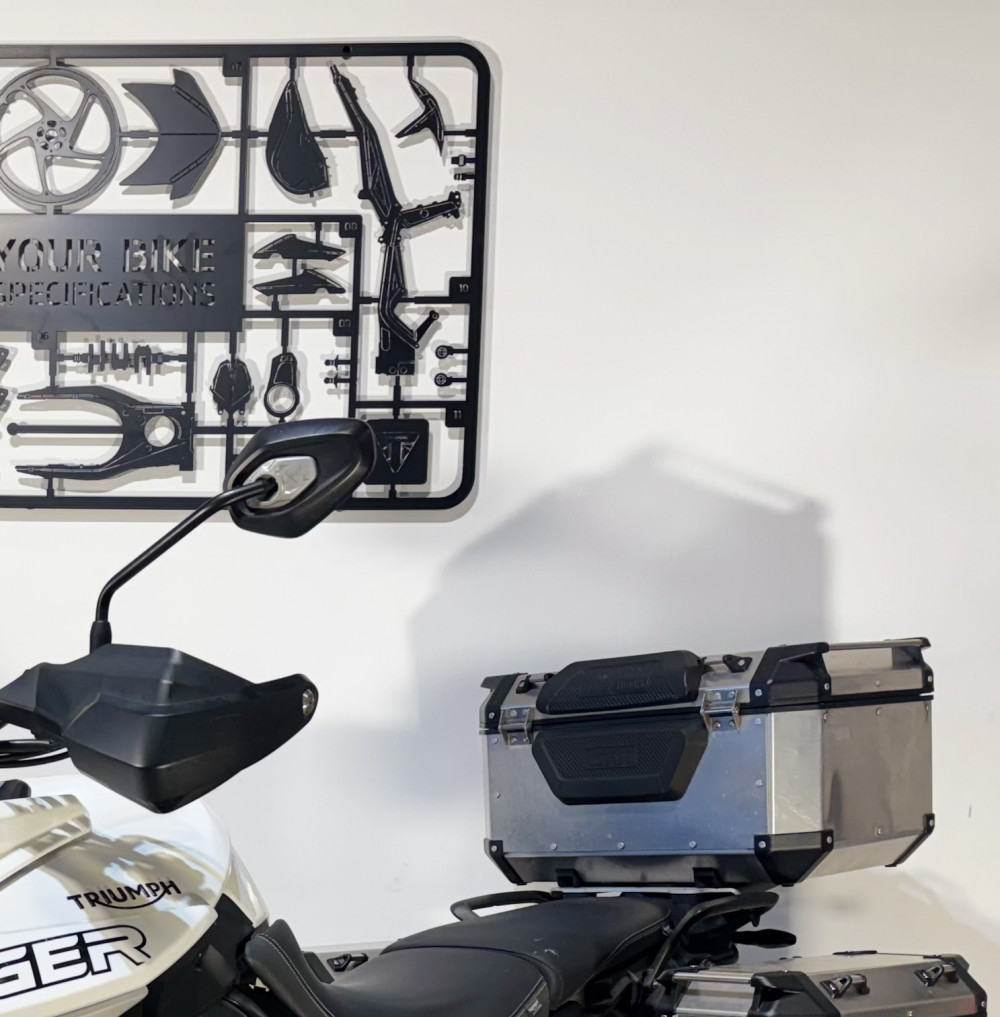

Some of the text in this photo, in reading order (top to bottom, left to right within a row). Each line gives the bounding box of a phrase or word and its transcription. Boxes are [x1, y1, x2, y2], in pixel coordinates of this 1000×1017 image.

[122, 238, 216, 273] BIKE
[458, 283, 469, 293] 10
[453, 410, 463, 419] 11
[66, 880, 182, 909] TRIUMPH
